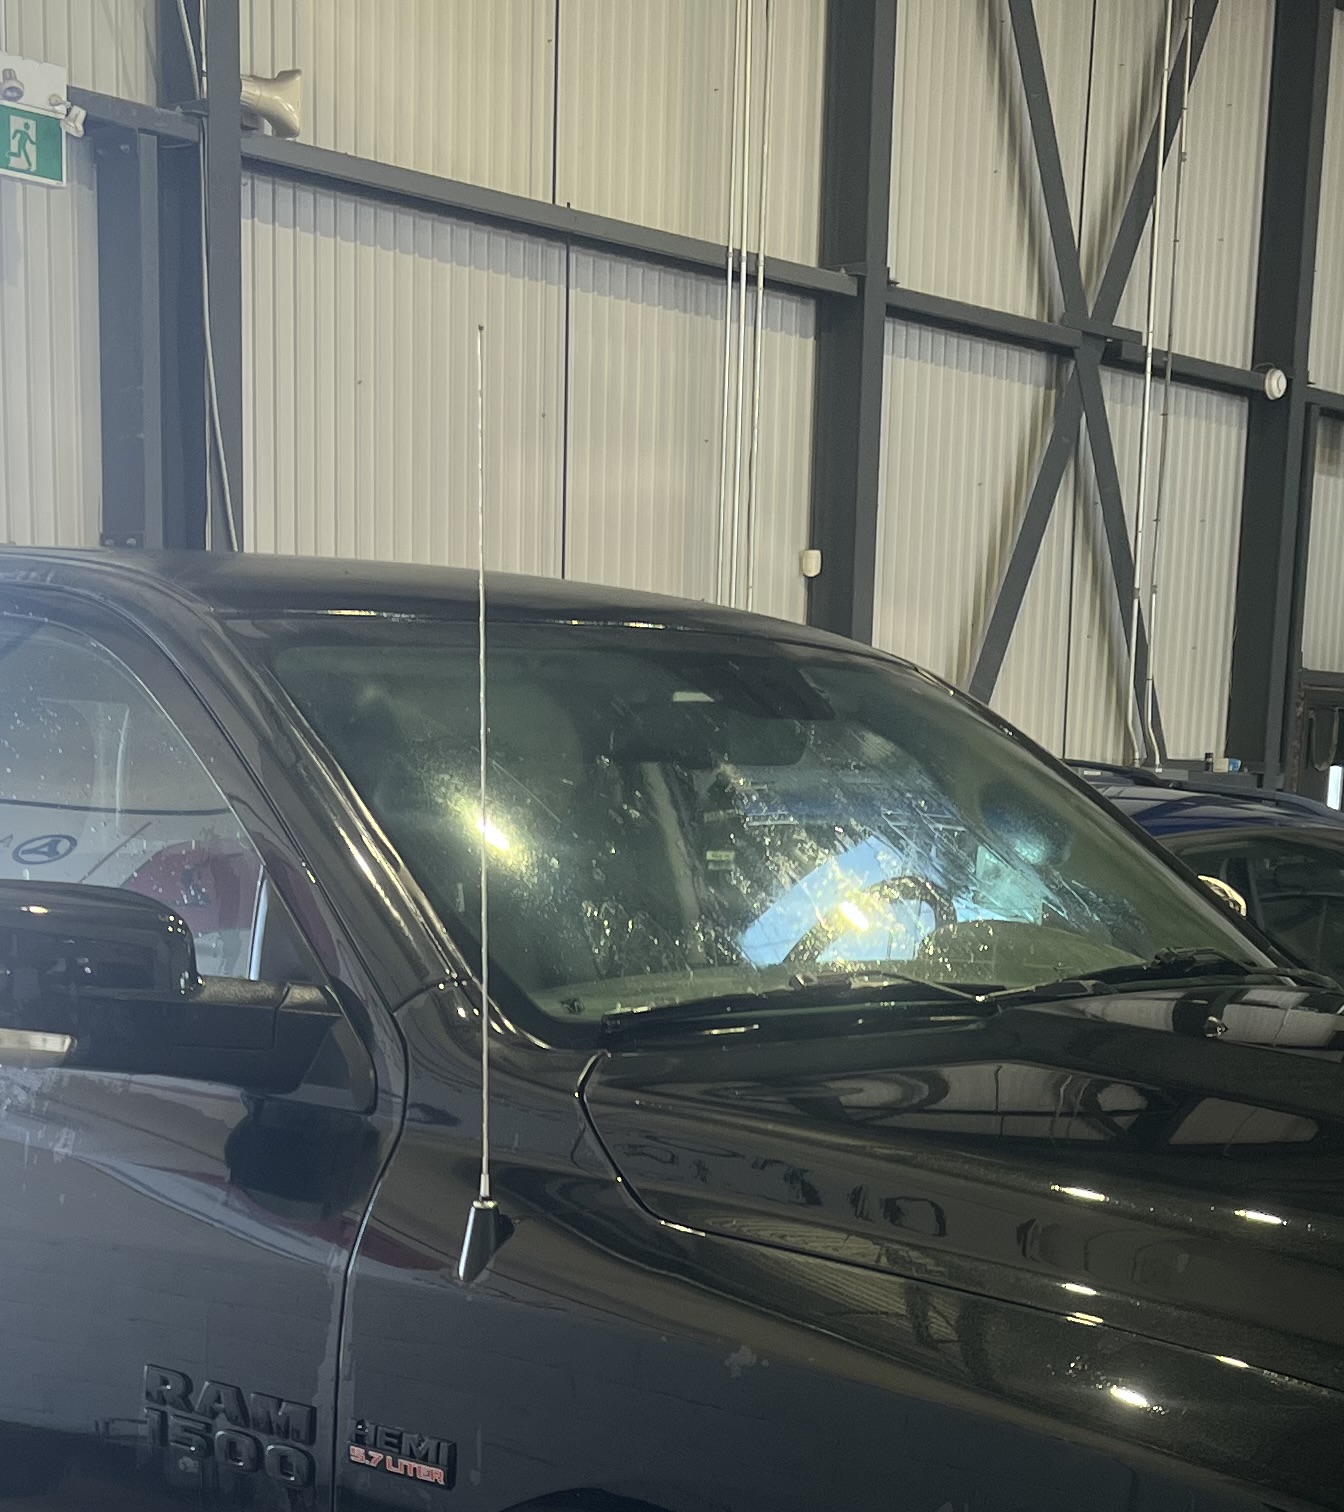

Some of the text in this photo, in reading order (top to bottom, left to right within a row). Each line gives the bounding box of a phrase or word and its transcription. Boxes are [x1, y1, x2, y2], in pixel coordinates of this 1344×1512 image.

[144, 1363, 317, 1447] RAM
[144, 1406, 316, 1488] 1500
[349, 1418, 453, 1467] HEMI
[349, 1444, 446, 1487] 5.7 LITER
